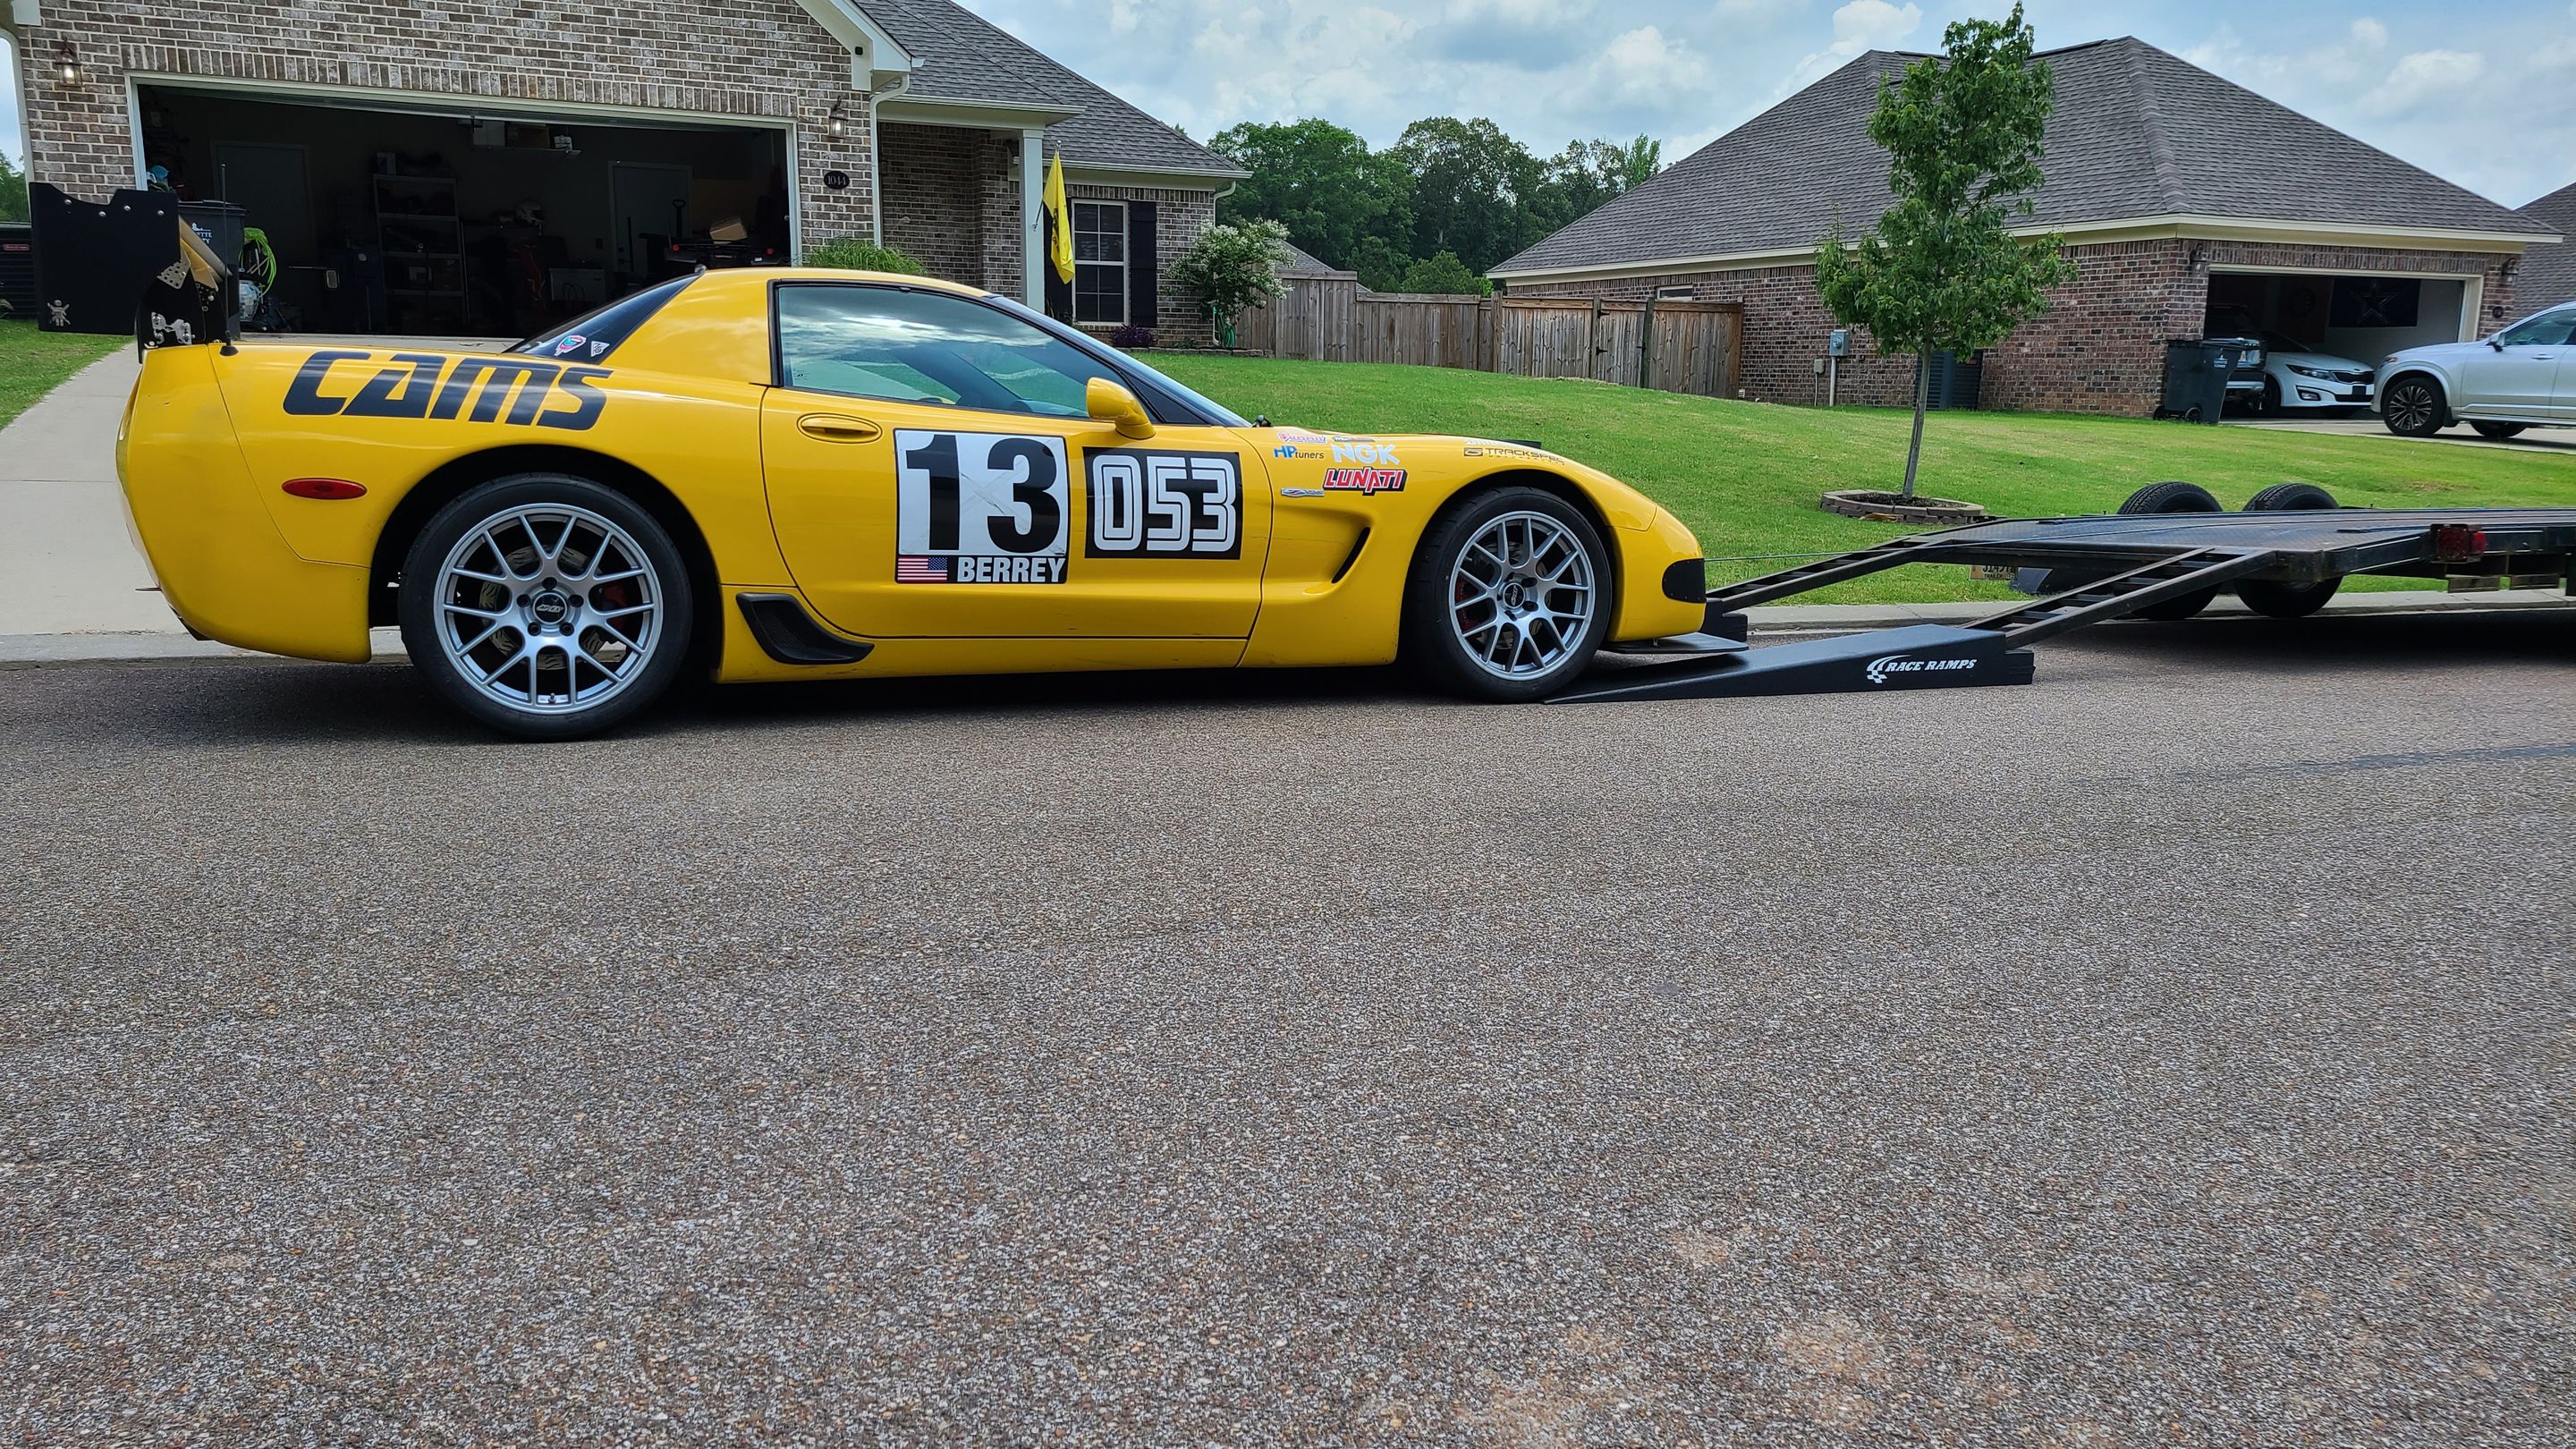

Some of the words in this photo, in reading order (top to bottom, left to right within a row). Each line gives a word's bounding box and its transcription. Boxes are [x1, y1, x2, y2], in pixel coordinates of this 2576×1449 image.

[1330, 443, 1401, 465] NGK
[906, 434, 1062, 554] 13
[1324, 467, 1405, 494] LUNATI
[1092, 454, 1237, 553] 053
[957, 556, 1066, 583] BERREY
[1885, 661, 1924, 672] RACE
[1924, 658, 1978, 671] RAMPS
